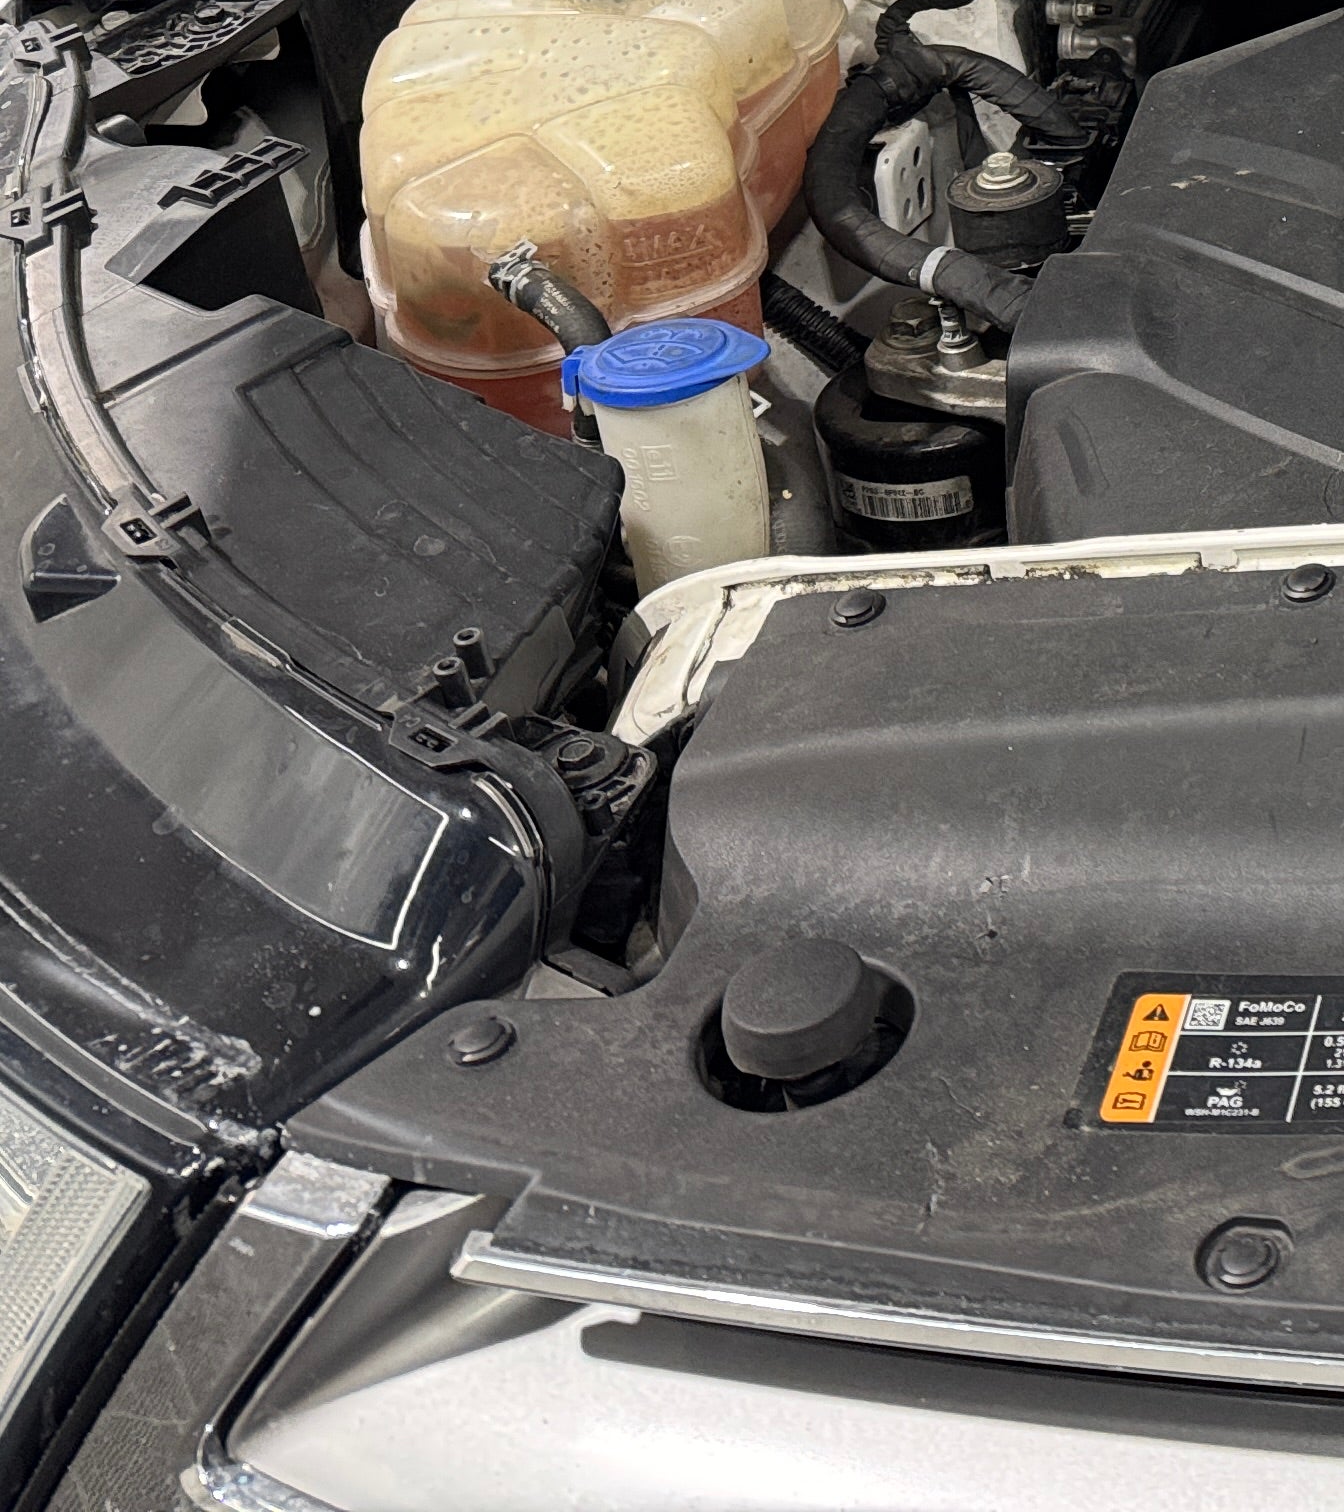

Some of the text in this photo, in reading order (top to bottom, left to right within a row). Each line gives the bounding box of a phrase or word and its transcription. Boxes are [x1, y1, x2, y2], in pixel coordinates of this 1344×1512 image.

[1238, 1000, 1306, 1013] FoMoCo
[1234, 1016, 1259, 1027] SAE
[1208, 1056, 1263, 1069] R-134a
[1312, 1084, 1335, 1096] 5.2
[1206, 1095, 1244, 1108] PAG
[1310, 1096, 1342, 1111] (155
